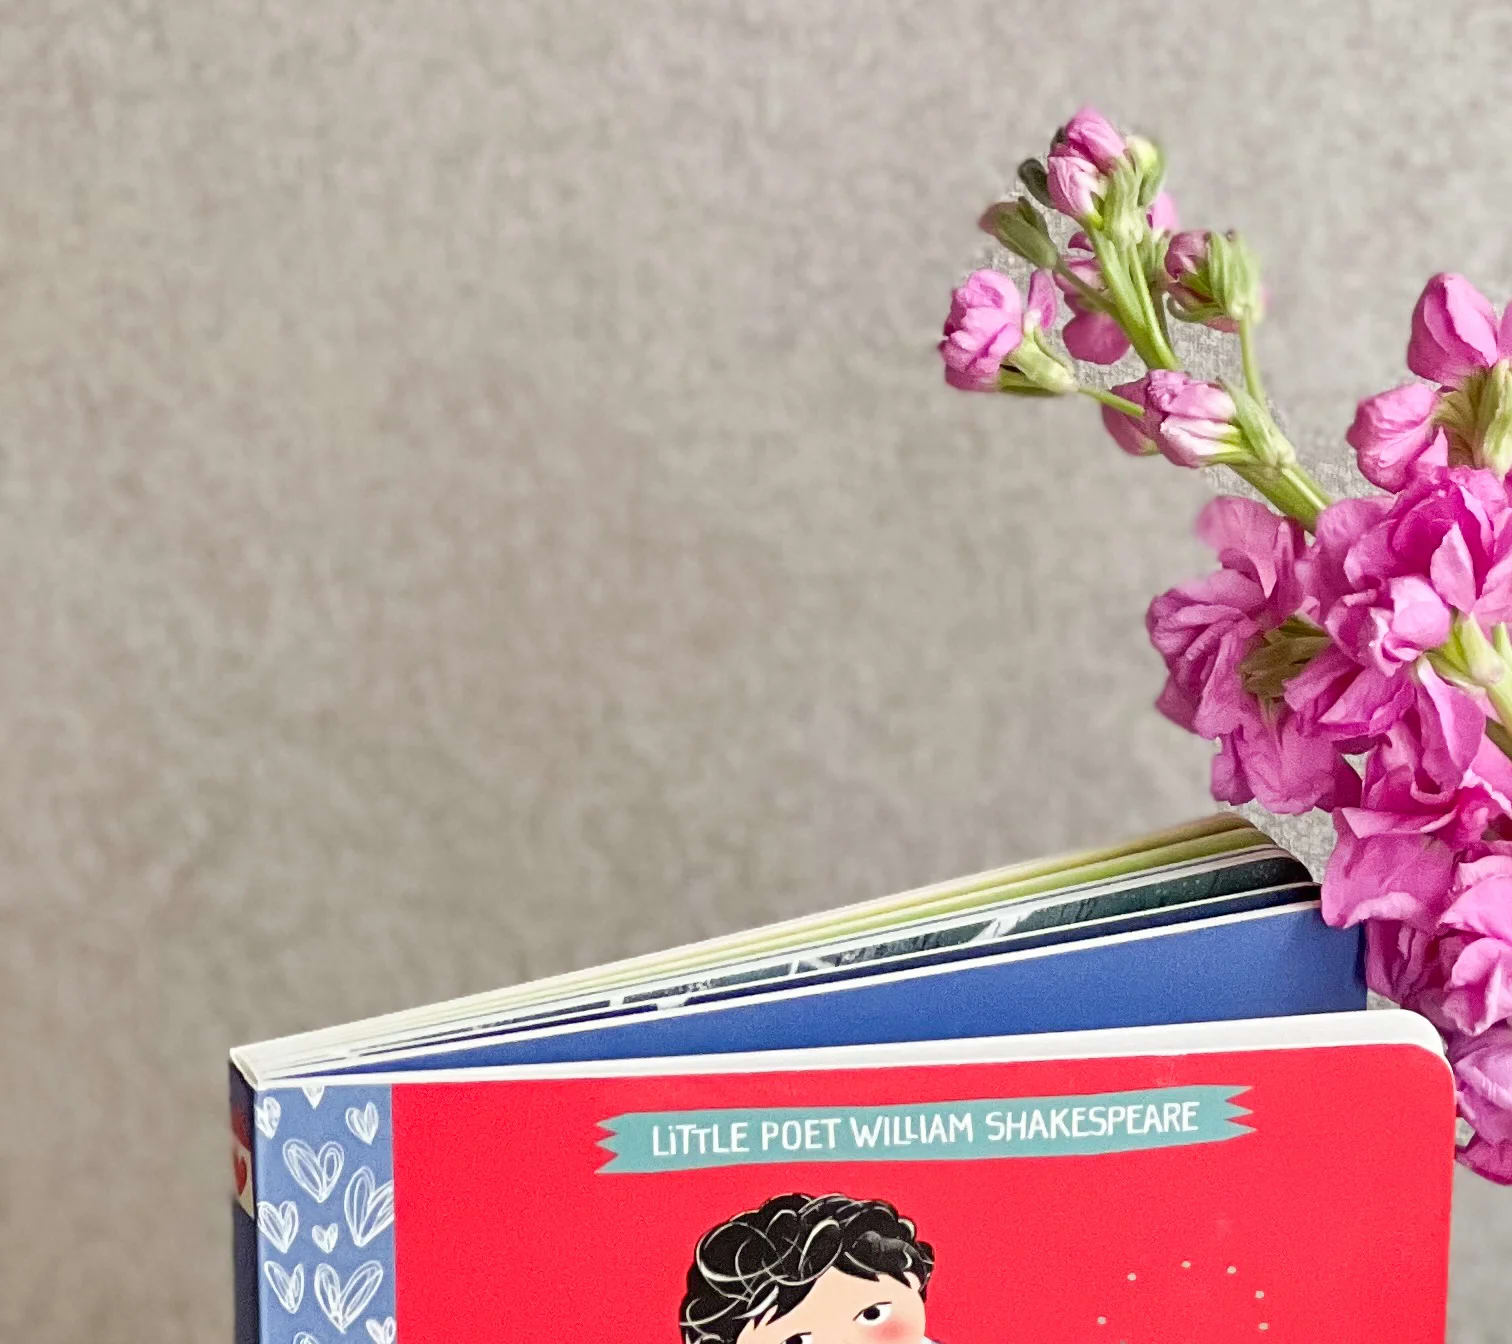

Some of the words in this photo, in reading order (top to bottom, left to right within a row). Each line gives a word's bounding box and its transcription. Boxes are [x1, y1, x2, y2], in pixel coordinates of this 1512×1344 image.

[761, 1117, 842, 1150] POET
[849, 1112, 974, 1148] WILLIAM
[985, 1101, 1201, 1142] SHAKESPEARE
